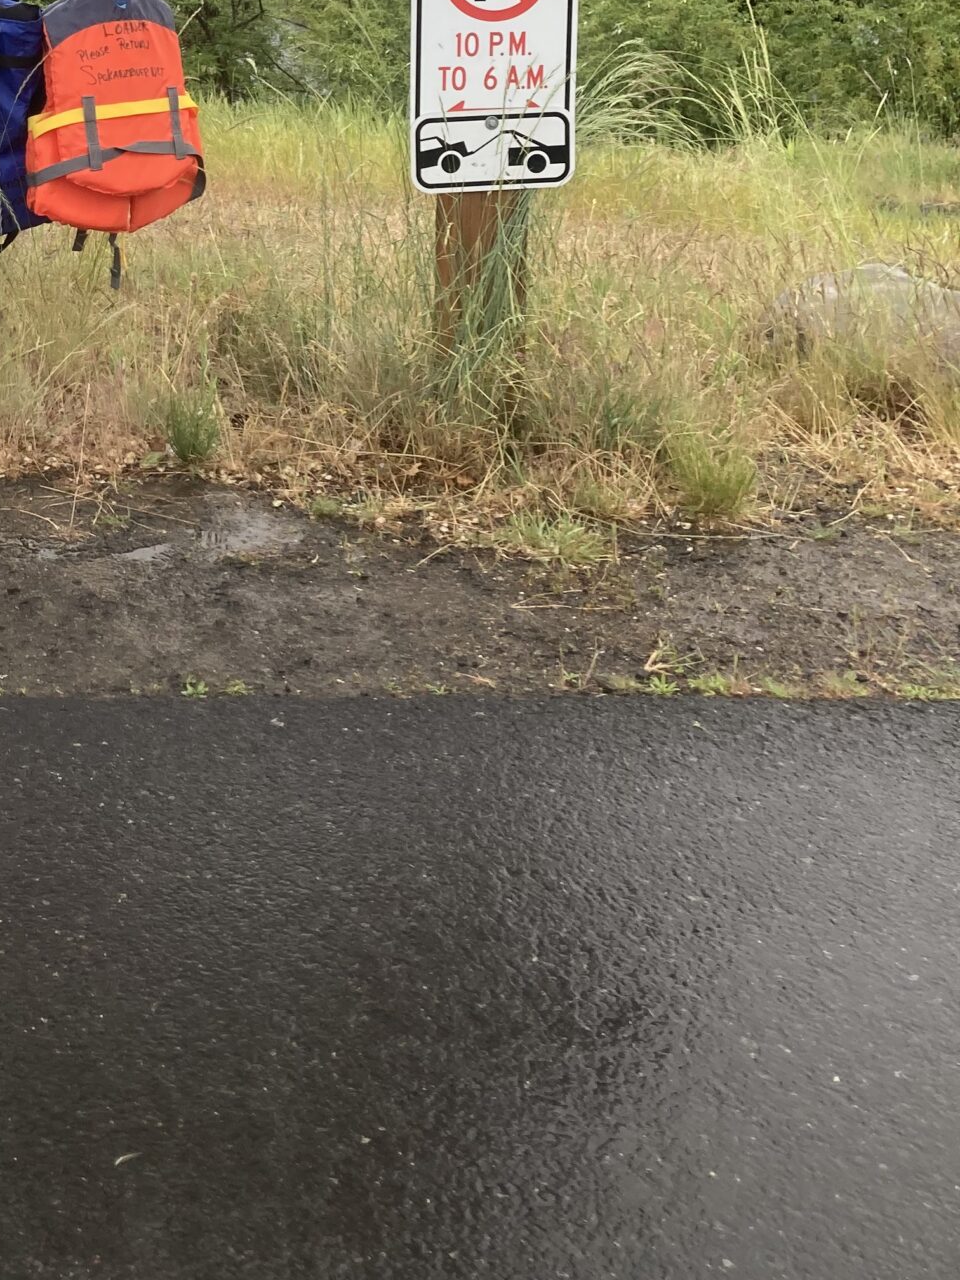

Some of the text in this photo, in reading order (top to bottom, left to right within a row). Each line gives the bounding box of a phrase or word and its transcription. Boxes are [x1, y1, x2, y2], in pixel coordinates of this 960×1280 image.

[75, 46, 111, 63] Please
[456, 32, 532, 58] 10 P.M.
[438, 65, 548, 92] TO 6 A.M.
